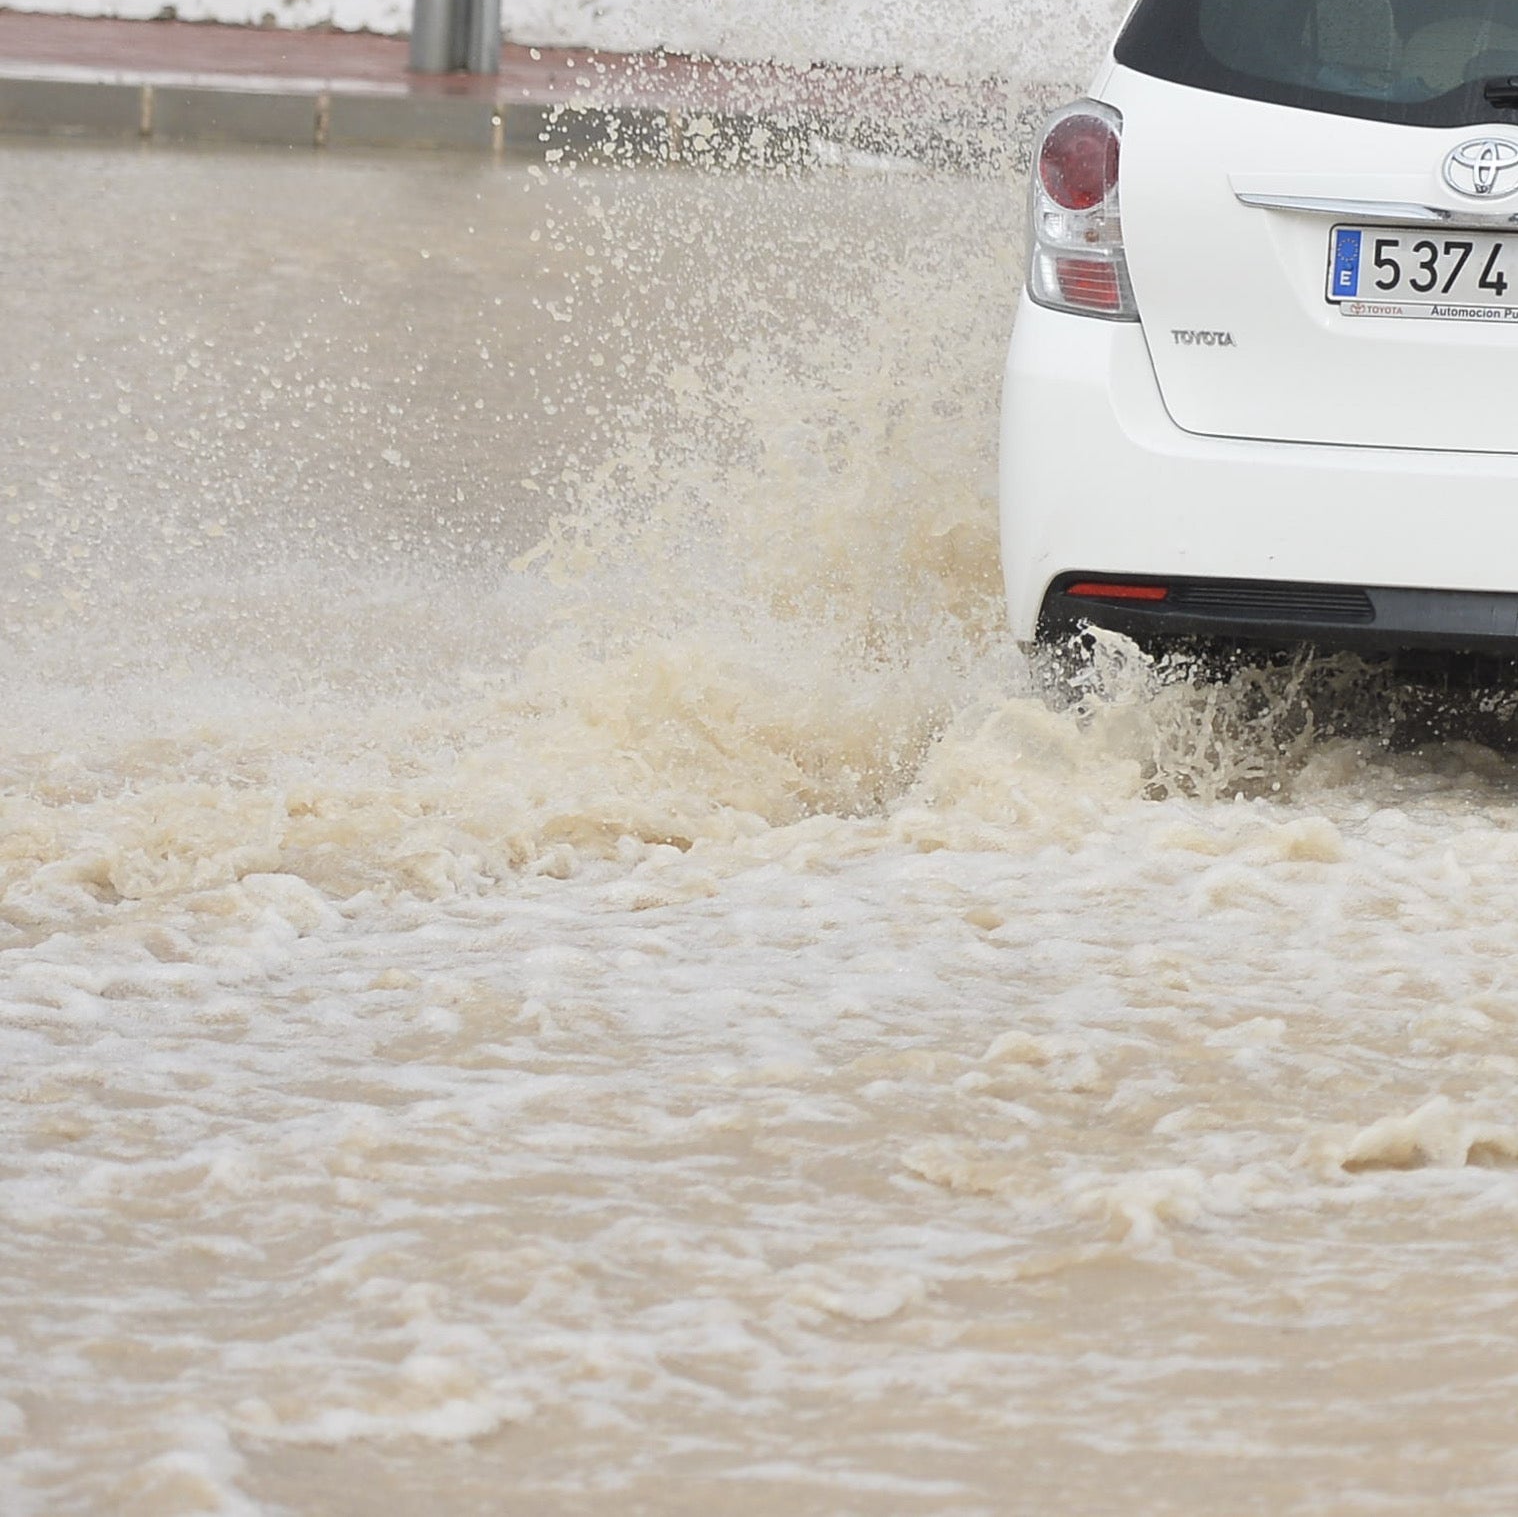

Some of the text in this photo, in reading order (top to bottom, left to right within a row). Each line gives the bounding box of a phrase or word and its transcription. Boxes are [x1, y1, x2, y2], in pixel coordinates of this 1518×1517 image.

[1373, 239, 1507, 297] 5374
[1366, 305, 1403, 315] TOYOTA
[1170, 330, 1238, 347] TOYOTA
